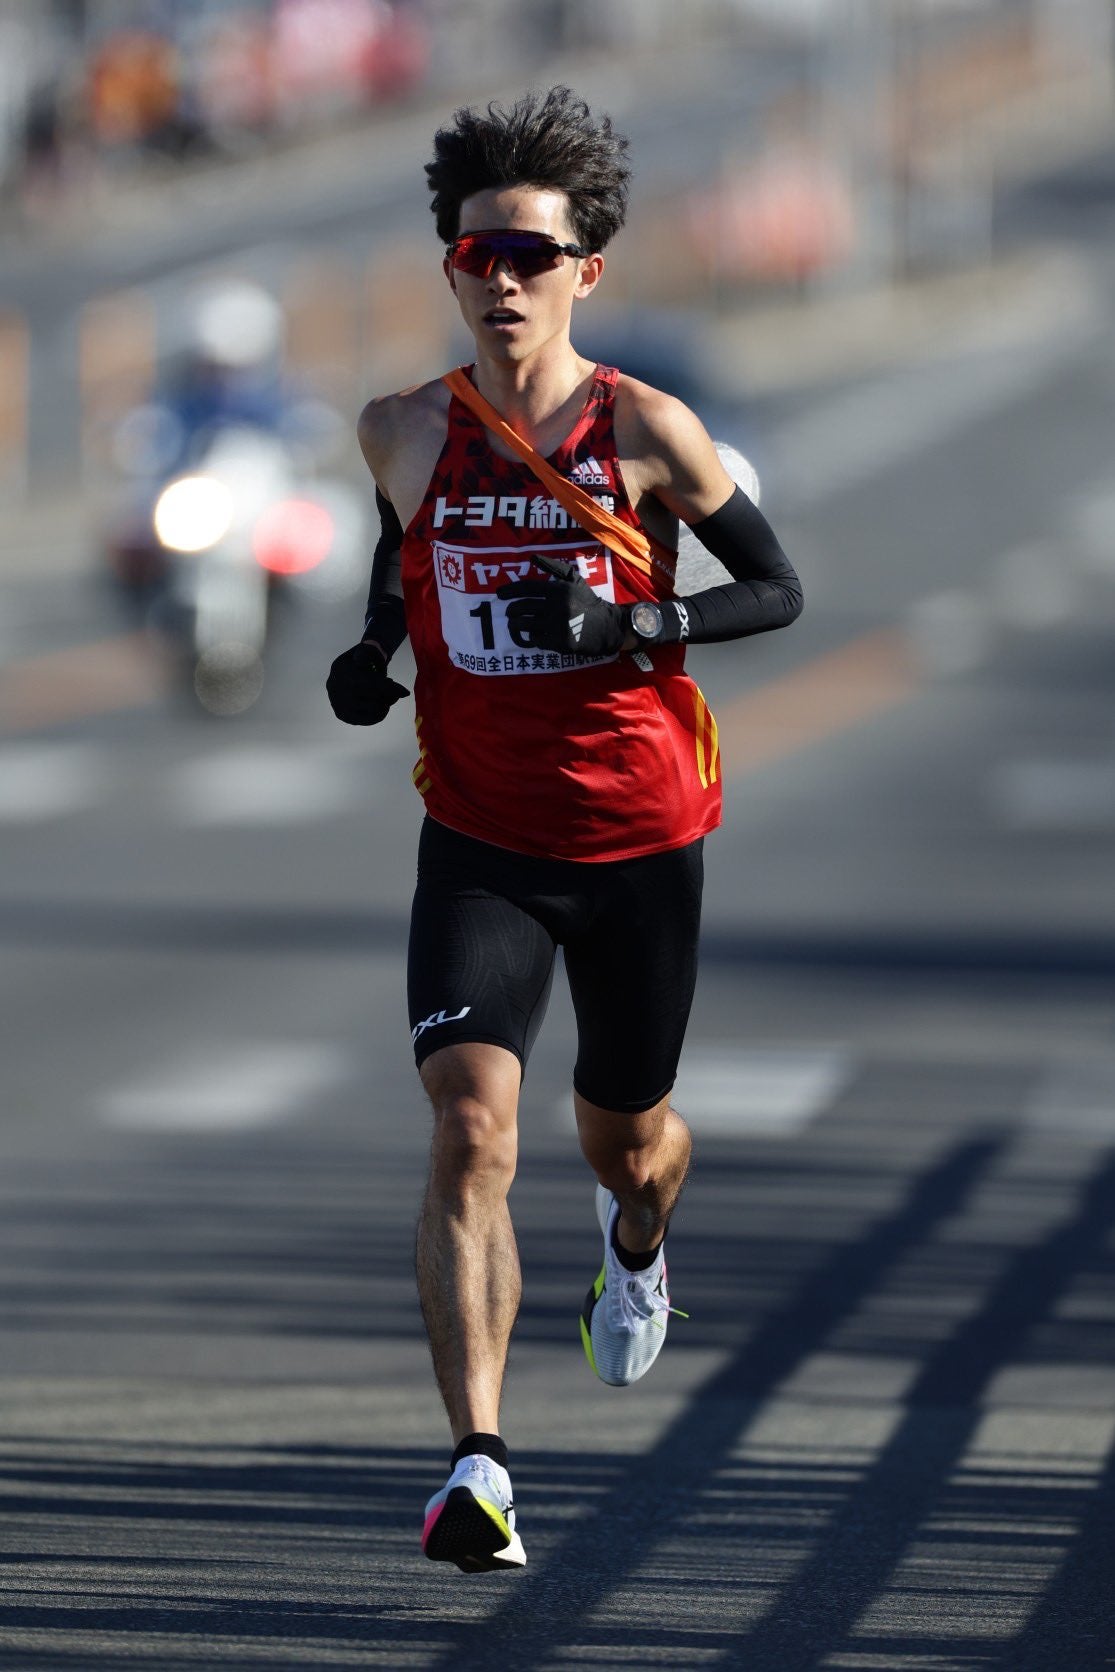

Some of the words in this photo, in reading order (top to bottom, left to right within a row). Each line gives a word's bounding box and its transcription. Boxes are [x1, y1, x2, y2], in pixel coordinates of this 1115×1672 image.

[567, 473, 610, 485] adidas
[470, 555, 599, 586] ヤマキ
